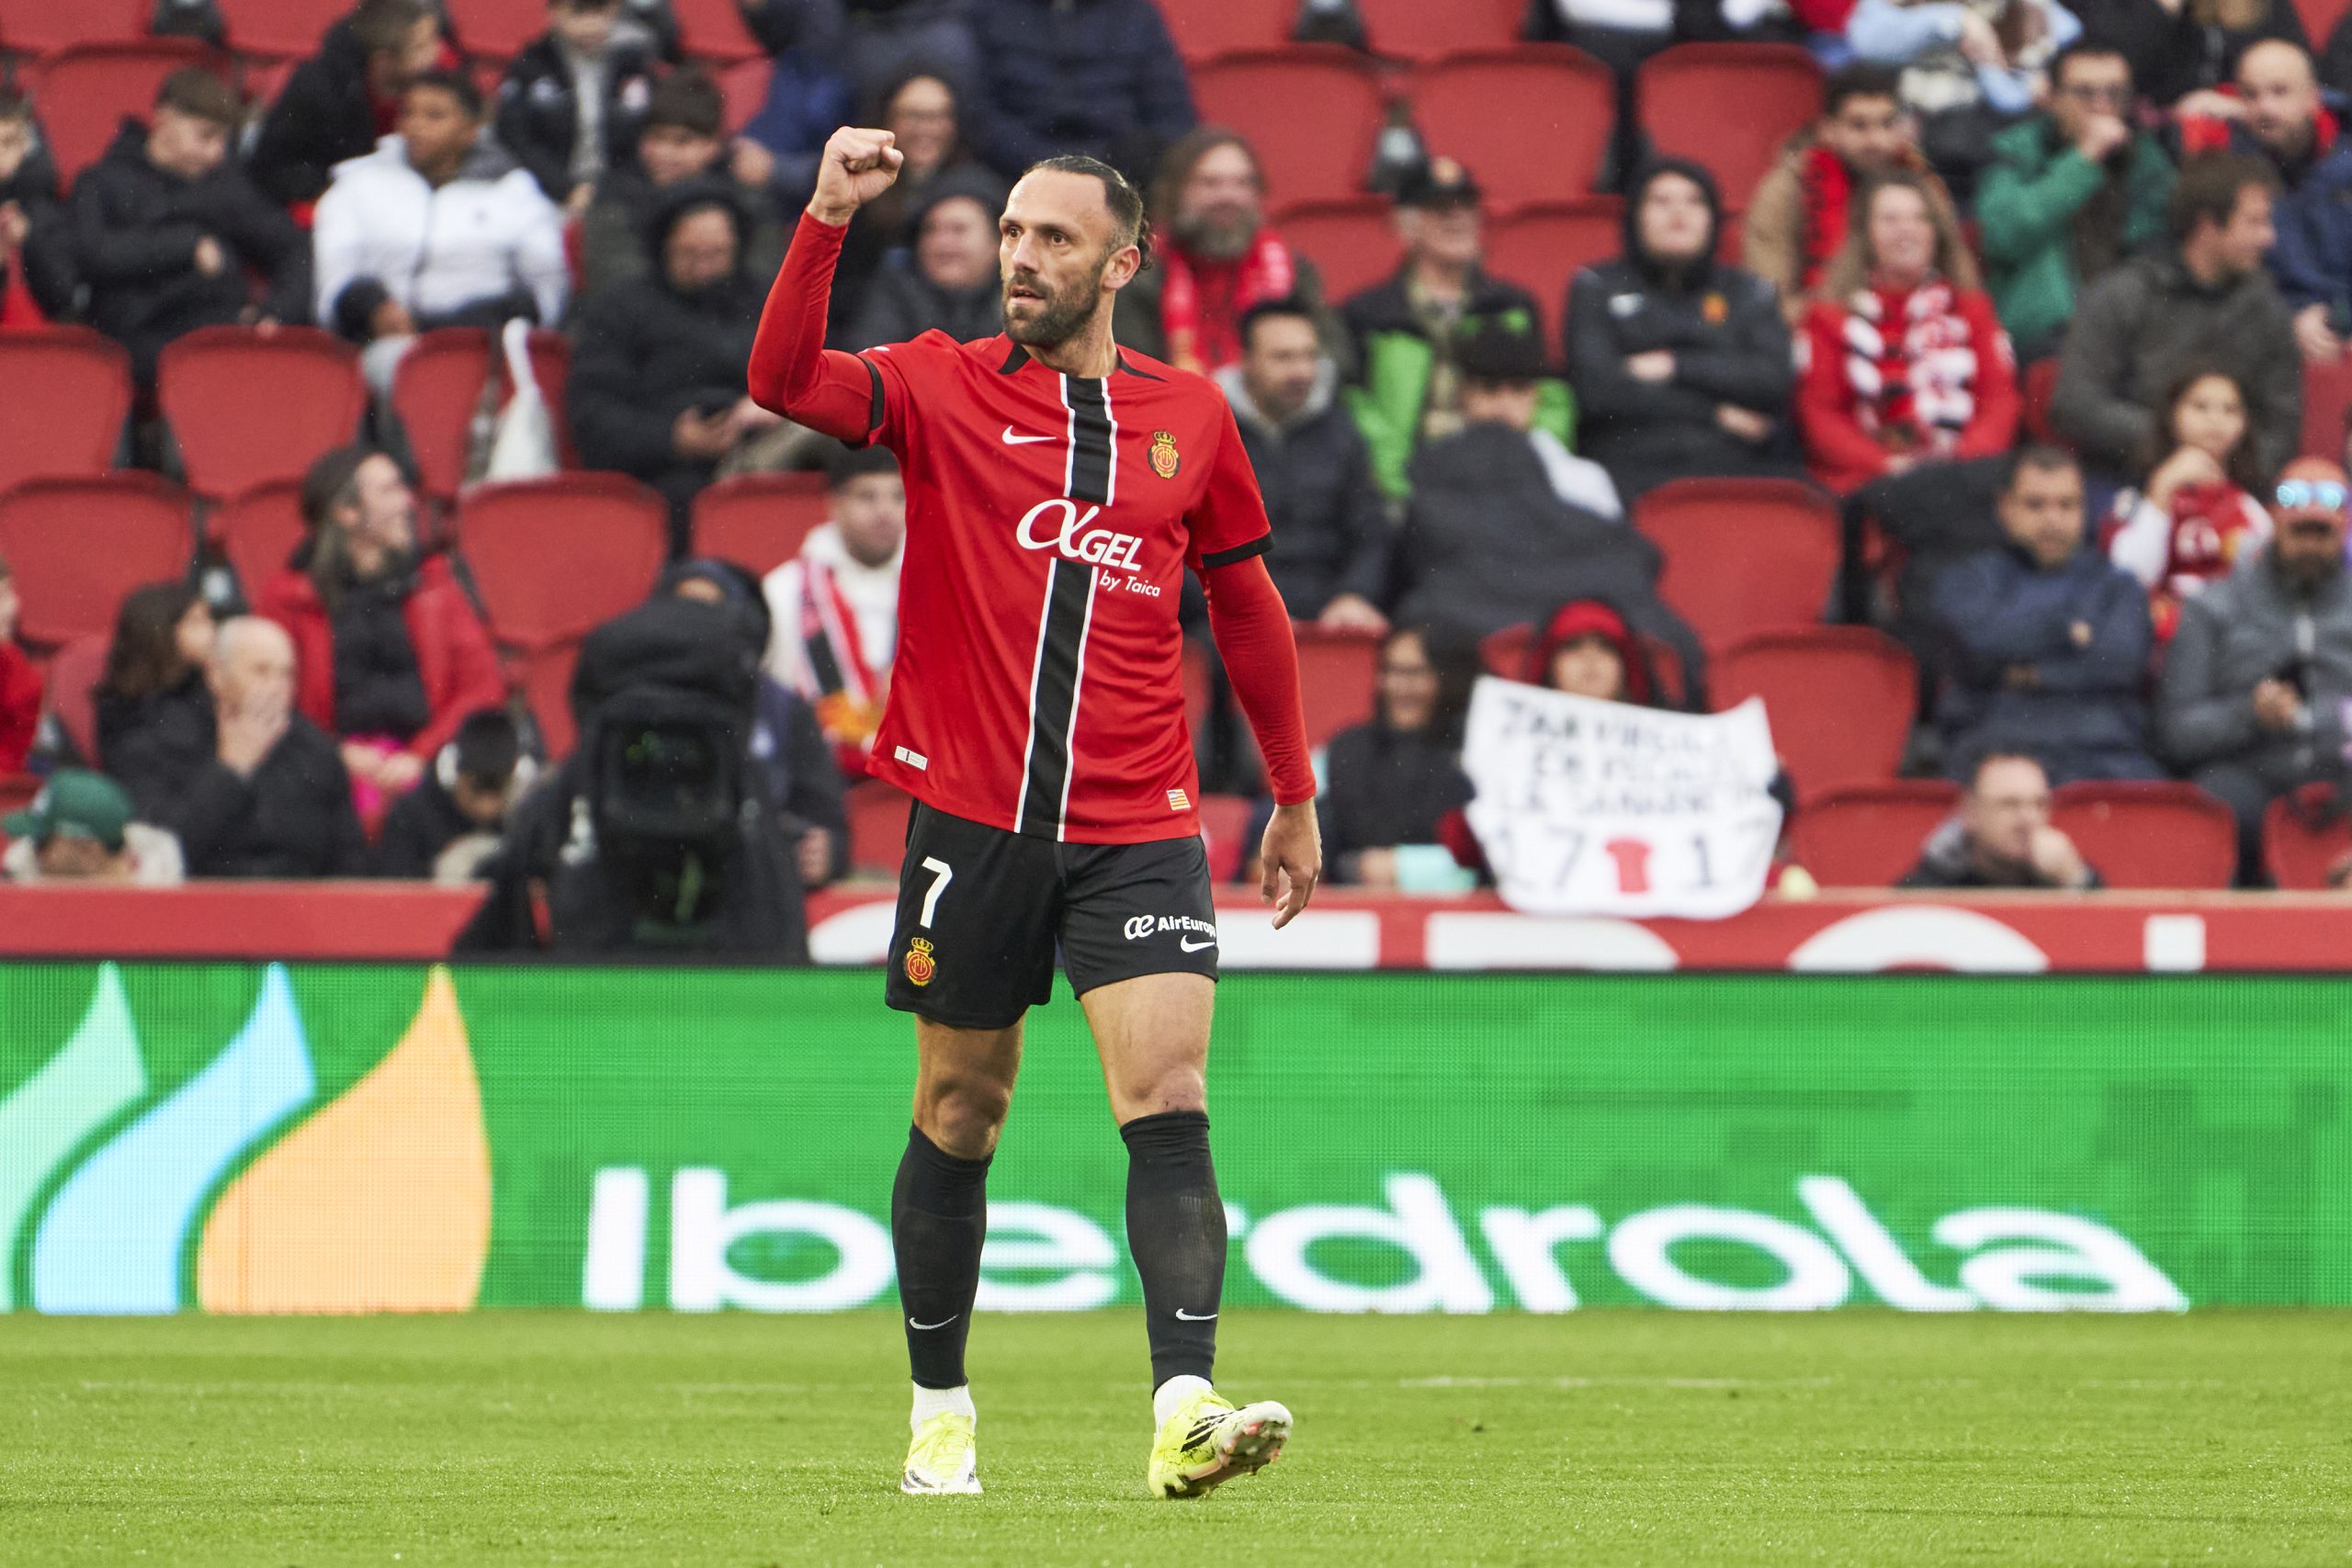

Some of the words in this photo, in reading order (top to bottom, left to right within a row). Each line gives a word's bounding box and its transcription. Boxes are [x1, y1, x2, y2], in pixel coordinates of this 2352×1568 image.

[1100, 570, 1121, 592] by
[1125, 576, 1161, 597] Taica
[920, 856, 953, 929] 7
[582, 1167, 2189, 1314] Ibedrola
